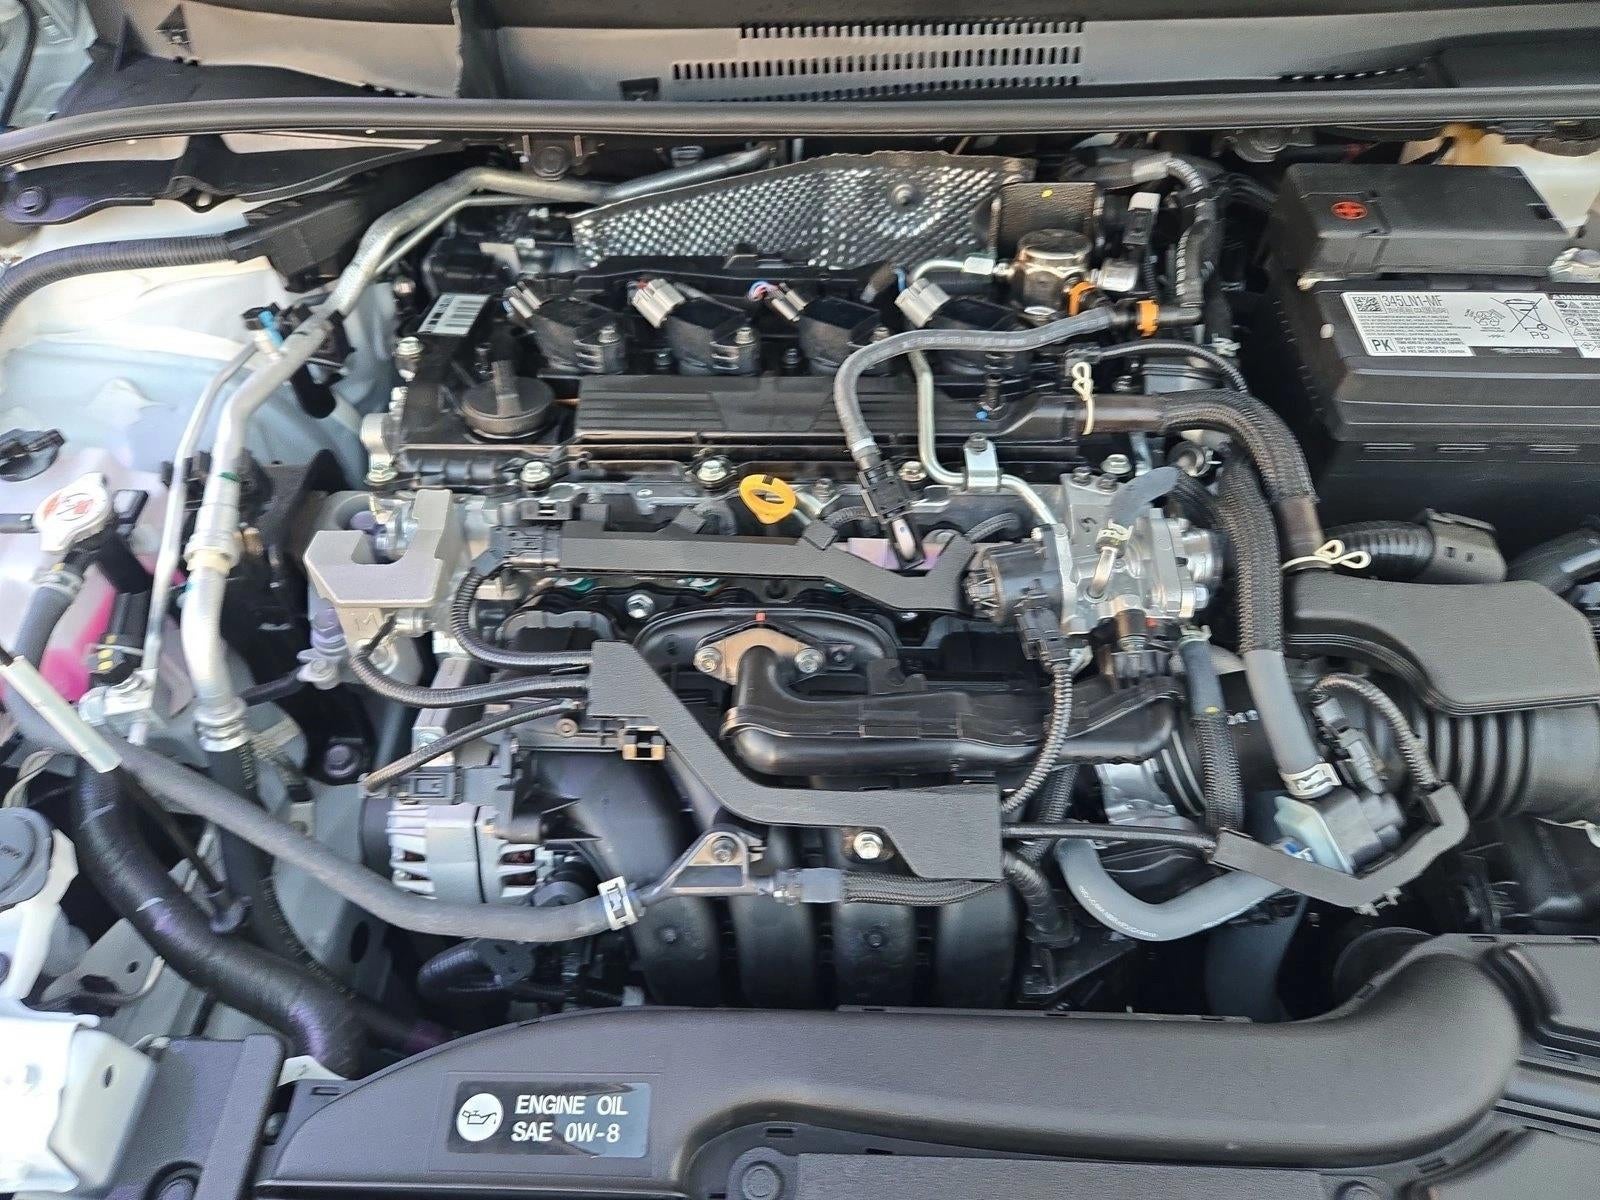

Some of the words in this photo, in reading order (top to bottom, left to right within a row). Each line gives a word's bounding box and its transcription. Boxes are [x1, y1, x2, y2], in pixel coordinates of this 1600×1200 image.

[1382, 295, 1443, 307] 345LN1-MF
[1530, 331, 1550, 340] Pb
[1371, 339, 1395, 352] PK
[514, 1094, 586, 1115] ENGINE
[596, 1095, 629, 1116] OIL
[511, 1121, 554, 1142] SAE
